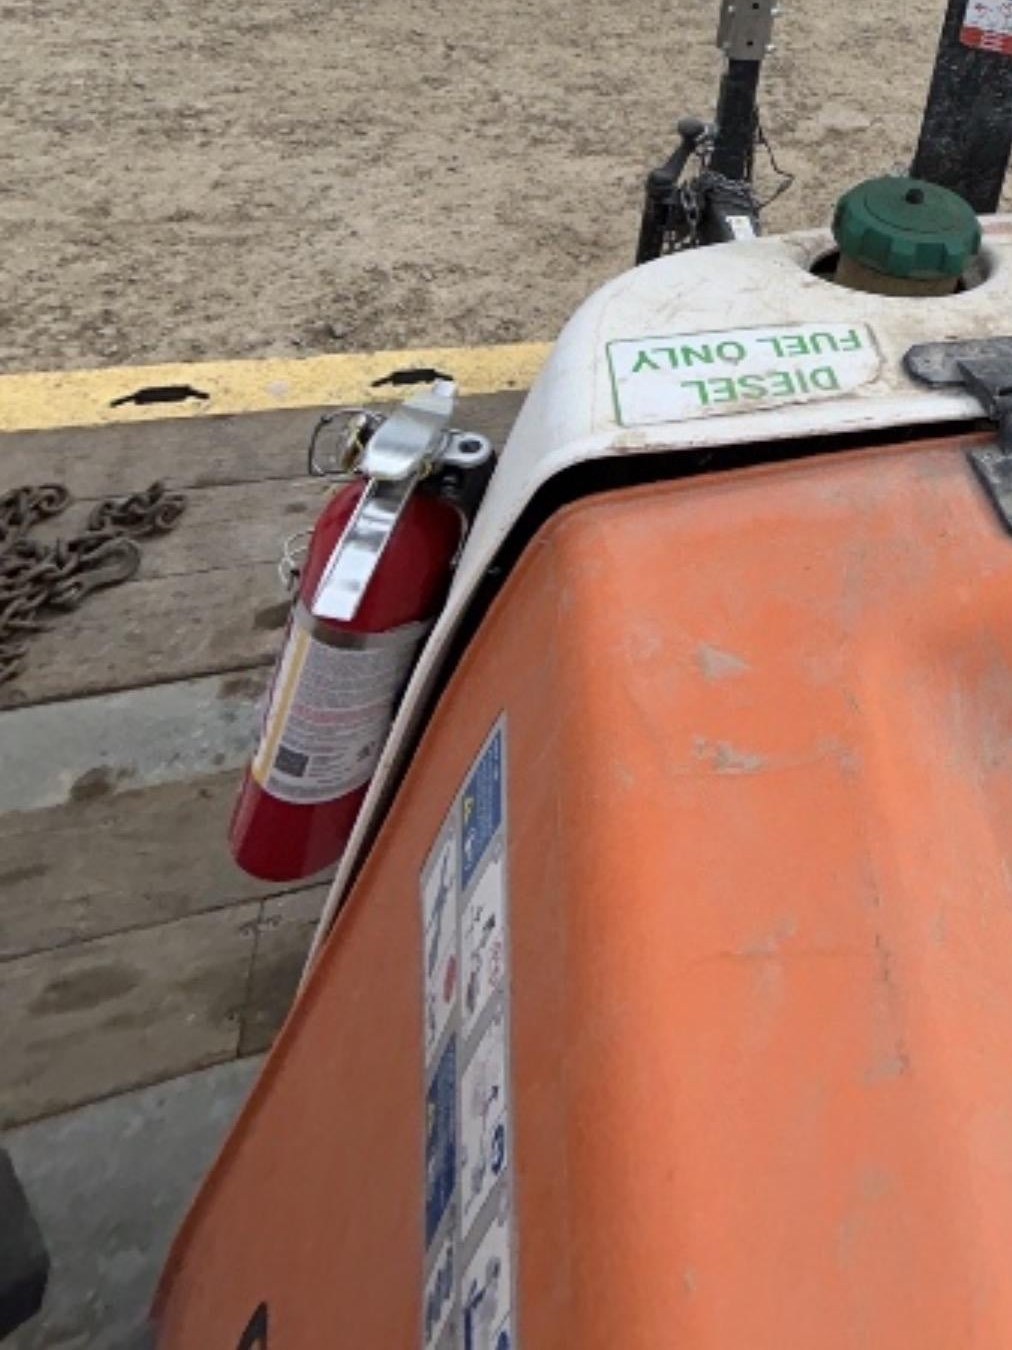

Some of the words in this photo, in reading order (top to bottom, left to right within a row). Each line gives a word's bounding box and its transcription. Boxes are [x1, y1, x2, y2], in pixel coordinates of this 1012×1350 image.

[632, 340, 747, 373] ONLY
[756, 329, 862, 358] FUEL
[681, 365, 840, 405] DIESEL
